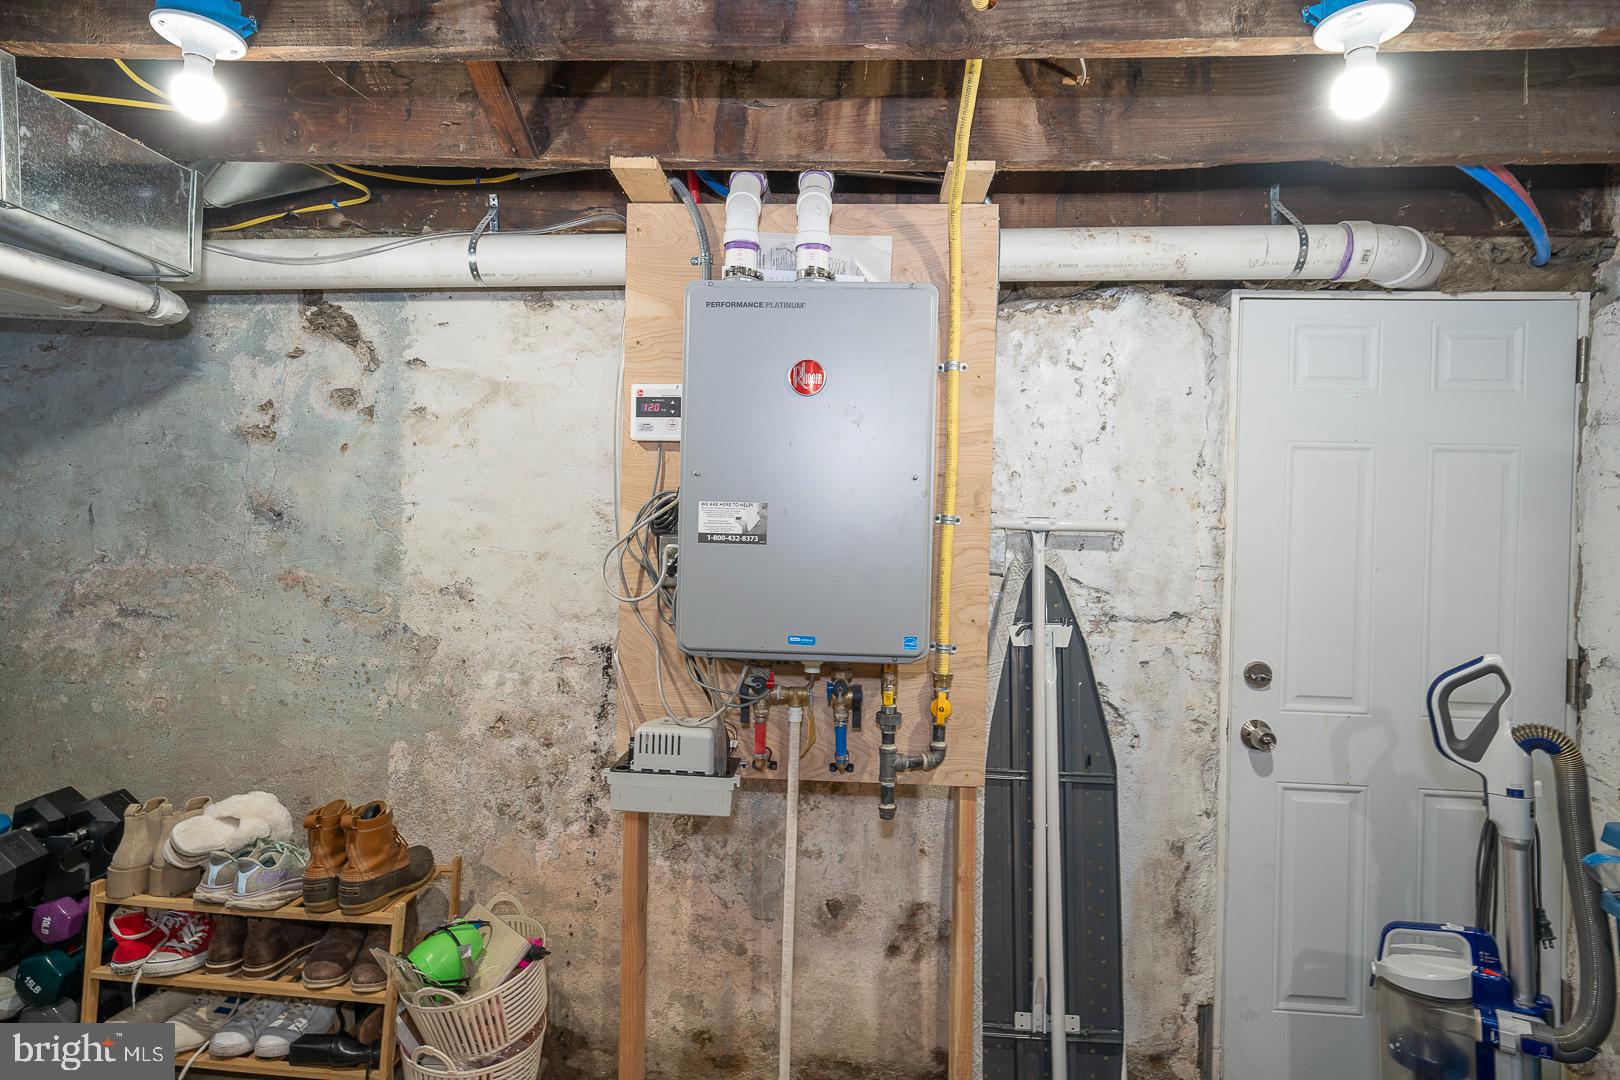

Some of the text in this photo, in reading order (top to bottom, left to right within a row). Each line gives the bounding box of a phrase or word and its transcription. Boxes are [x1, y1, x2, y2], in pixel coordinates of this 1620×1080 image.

[643, 403, 660, 412] 120
[706, 534, 759, 542] 1-800-432-8373
[24, 976, 42, 994] 15LB
